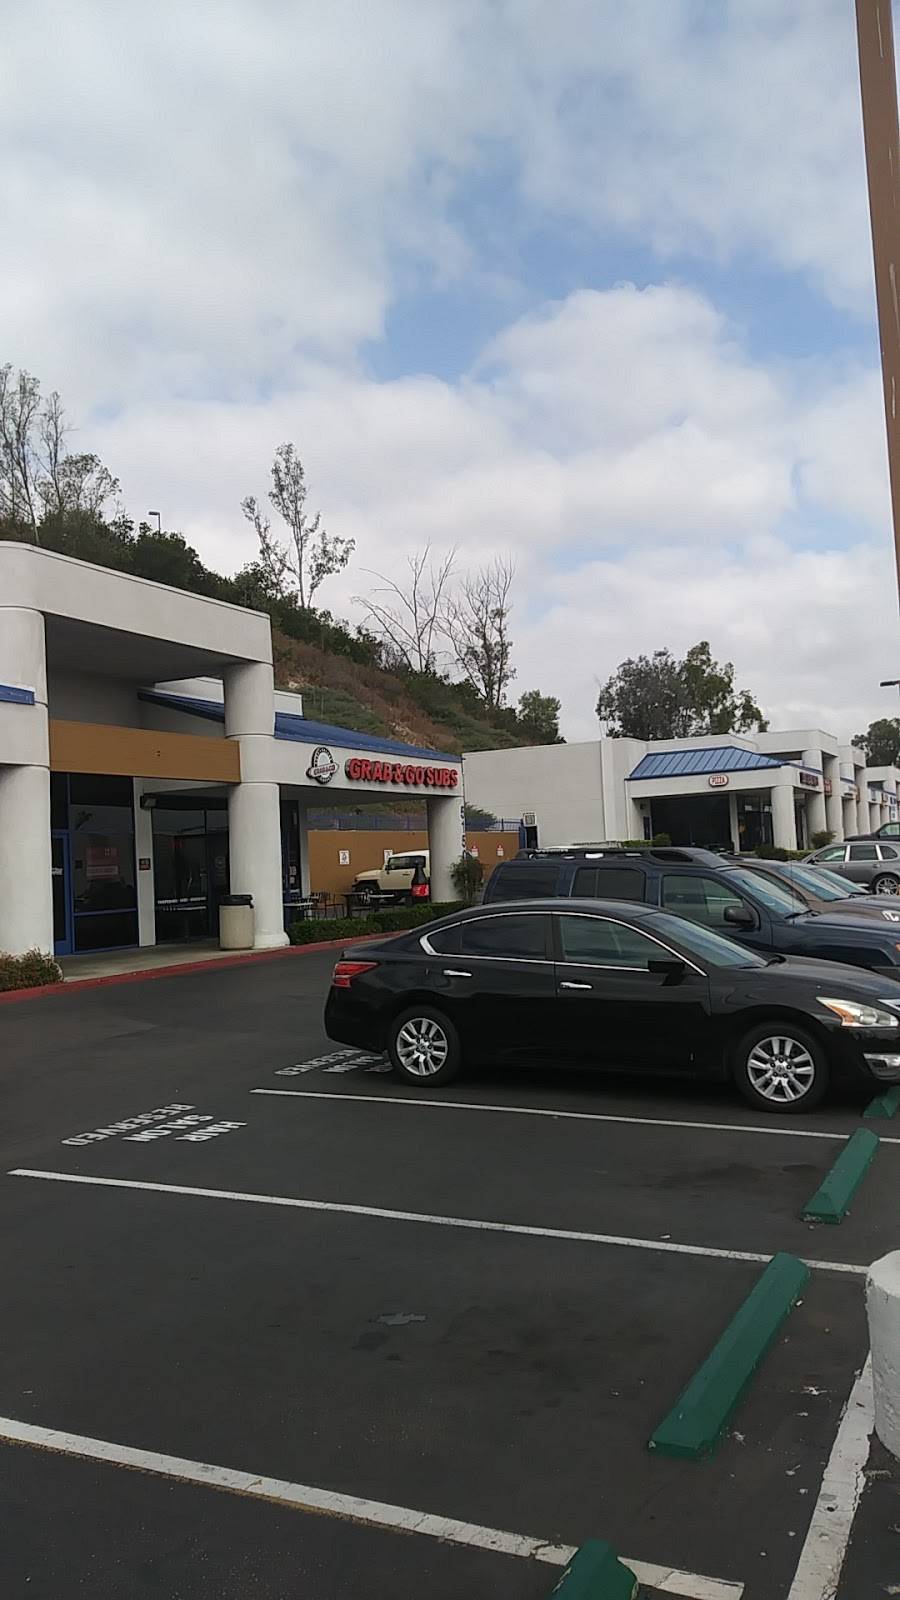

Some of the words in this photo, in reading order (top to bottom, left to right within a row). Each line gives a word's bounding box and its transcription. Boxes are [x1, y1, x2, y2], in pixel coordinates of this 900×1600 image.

[426, 767, 458, 787] SUBS
[61, 1103, 196, 1146] RESERVED
[121, 1114, 214, 1142] SALON
[173, 1120, 248, 1142] HAIR
